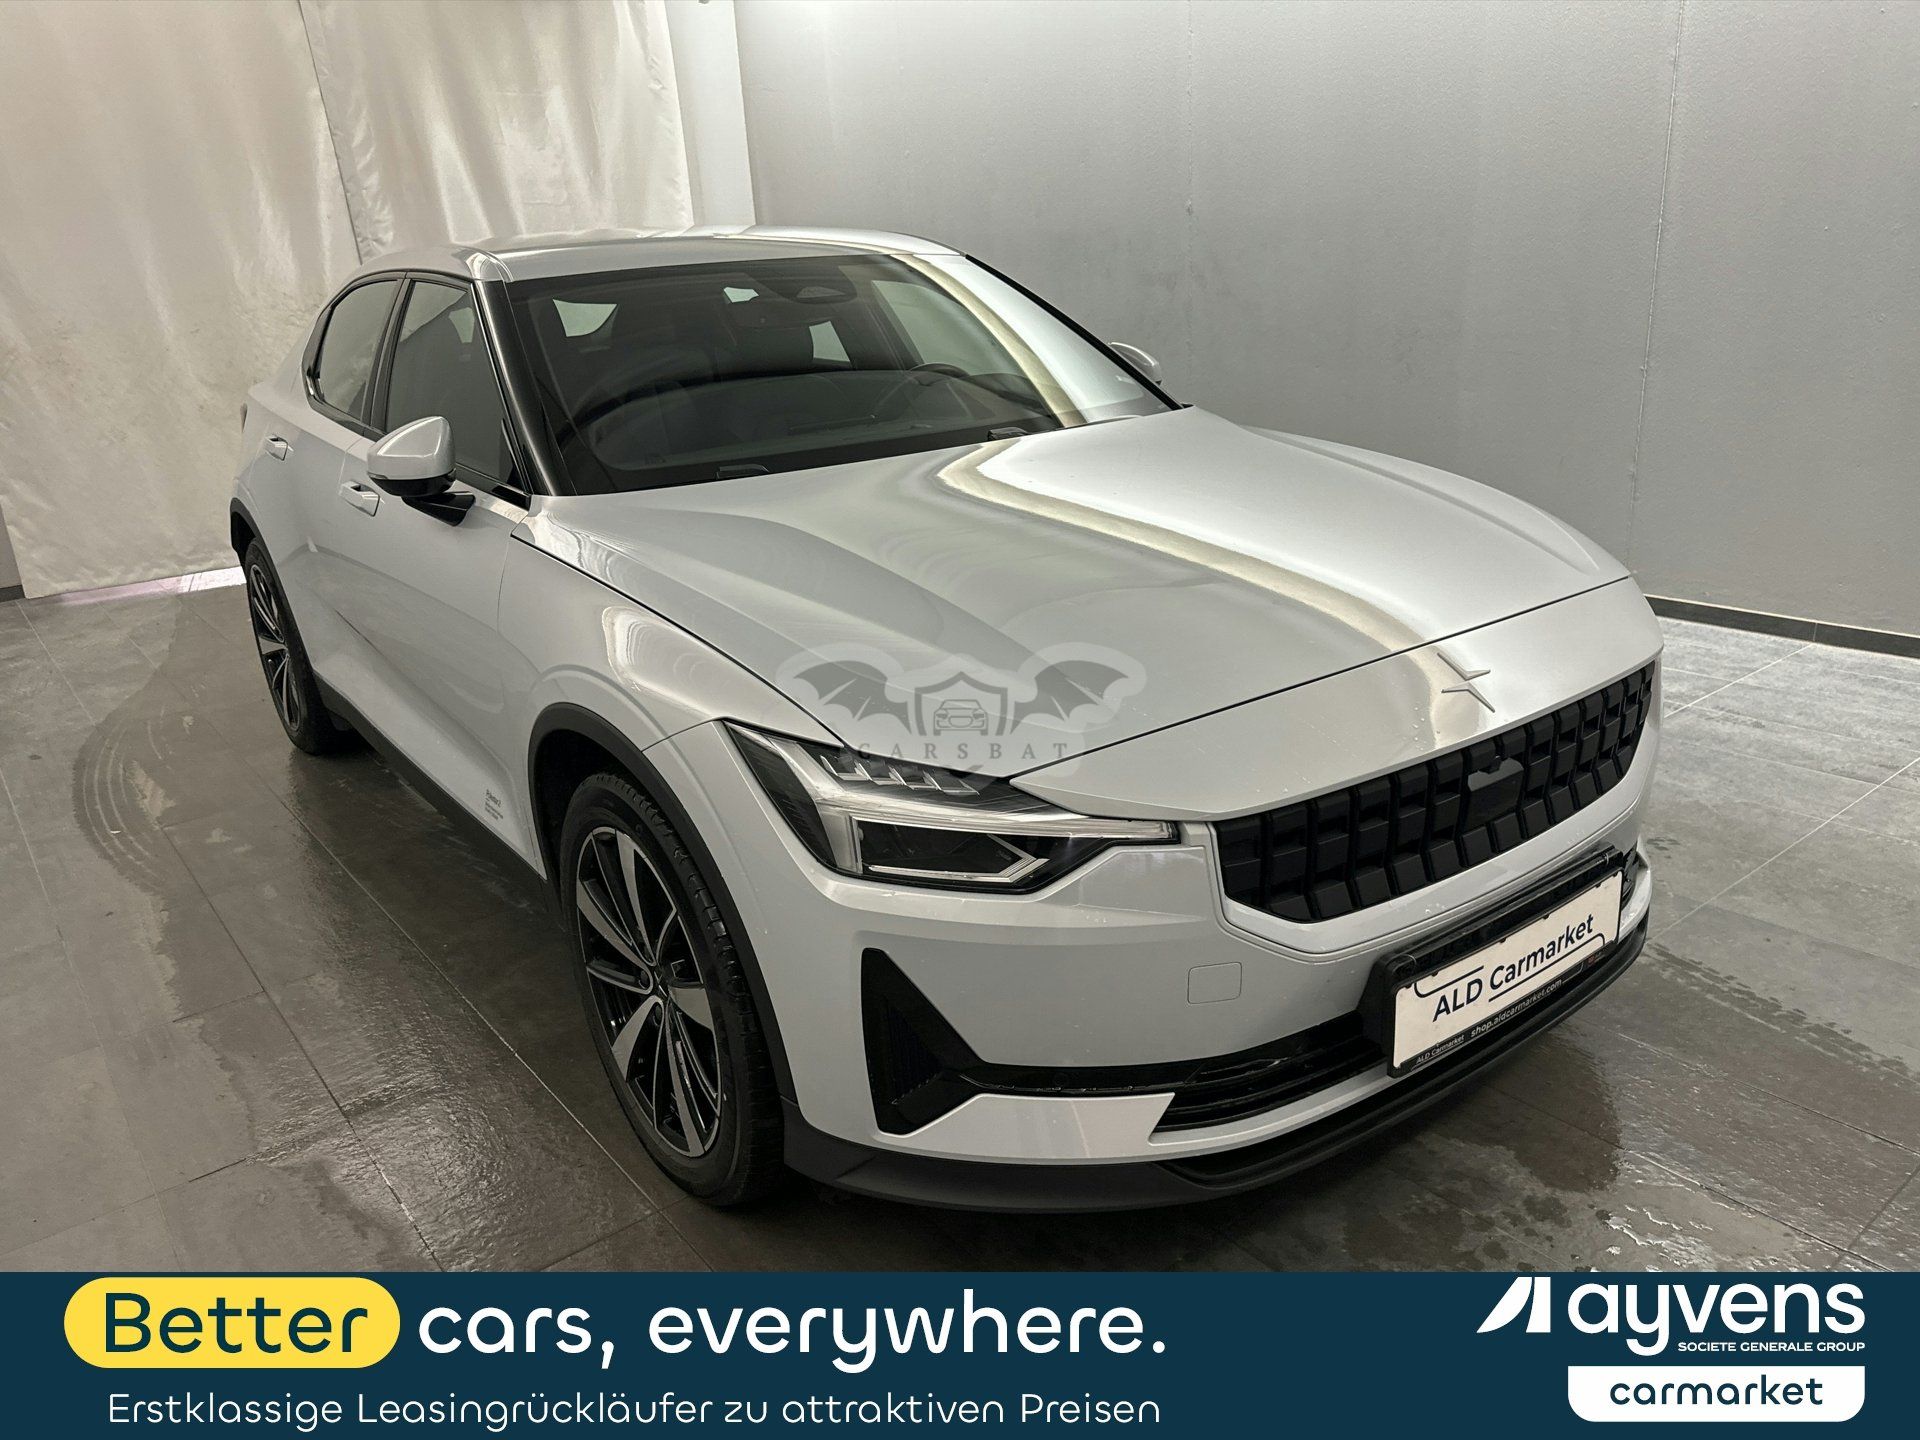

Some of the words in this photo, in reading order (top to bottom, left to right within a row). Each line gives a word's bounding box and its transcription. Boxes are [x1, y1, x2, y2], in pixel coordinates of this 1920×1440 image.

[1432, 978, 1482, 1023] ALD
[1489, 914, 1594, 990] Carmarket
[1470, 979, 1562, 1038] shop.aldcarmarket.com
[1416, 1050, 1430, 1064] ALD
[1431, 1034, 1465, 1057] Carmarket
